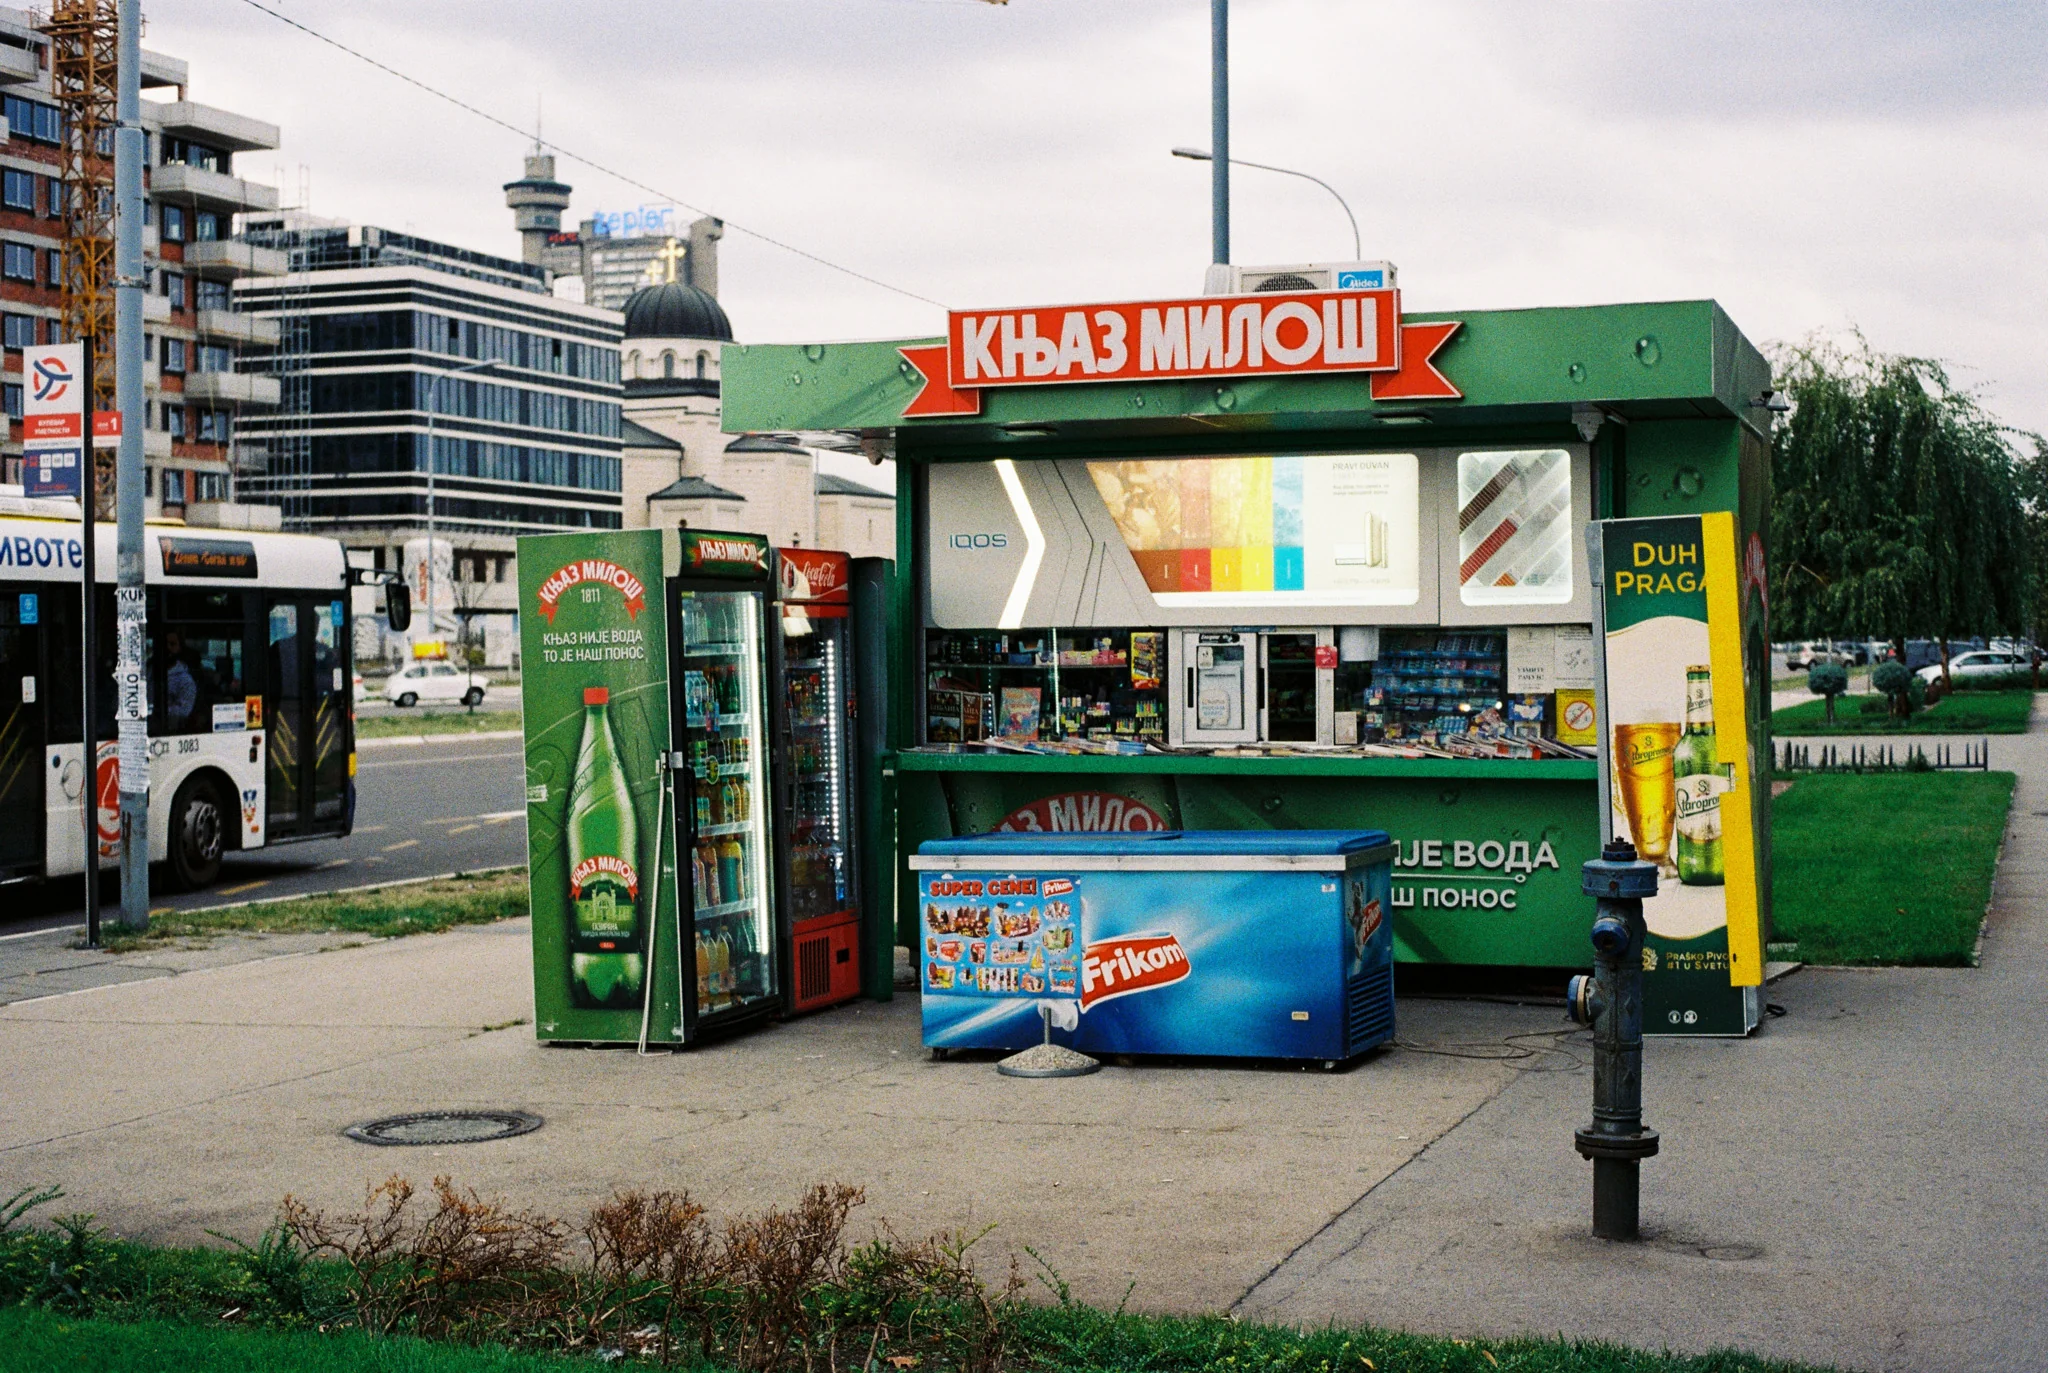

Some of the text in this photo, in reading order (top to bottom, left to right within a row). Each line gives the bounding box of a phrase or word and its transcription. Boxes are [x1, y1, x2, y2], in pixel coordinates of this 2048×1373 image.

[1345, 276, 1379, 289] Midea
[963, 298, 1378, 381] КЊАЗ МИЛОШ
[110, 417, 118, 431] 1
[700, 540, 757, 561] КЊАЗ МИЛОШ
[949, 533, 1007, 550] IQOS
[1633, 542, 1697, 567] DUH
[540, 561, 644, 604] КЊАЗ МИЛОШ
[581, 588, 600, 603] 1811
[544, 629, 644, 646] КЊАЗ НИЈЕ ВОДА
[544, 646, 644, 662] ТО ЈЕ НАШ ПОНОС
[127, 672, 140, 719] OTKUP
[178, 739, 200, 753] 3083
[1048, 795, 1164, 832] МИЛО
[1453, 840, 1560, 873] ВОДА
[571, 857, 638, 886] КЊАЗ МИЛОШ
[930, 879, 1038, 897] SUPER CENE!
[1422, 888, 1517, 908] ПОНОС
[1666, 951, 1705, 960] PRAŠKO
[1082, 943, 1185, 994] Frikom
